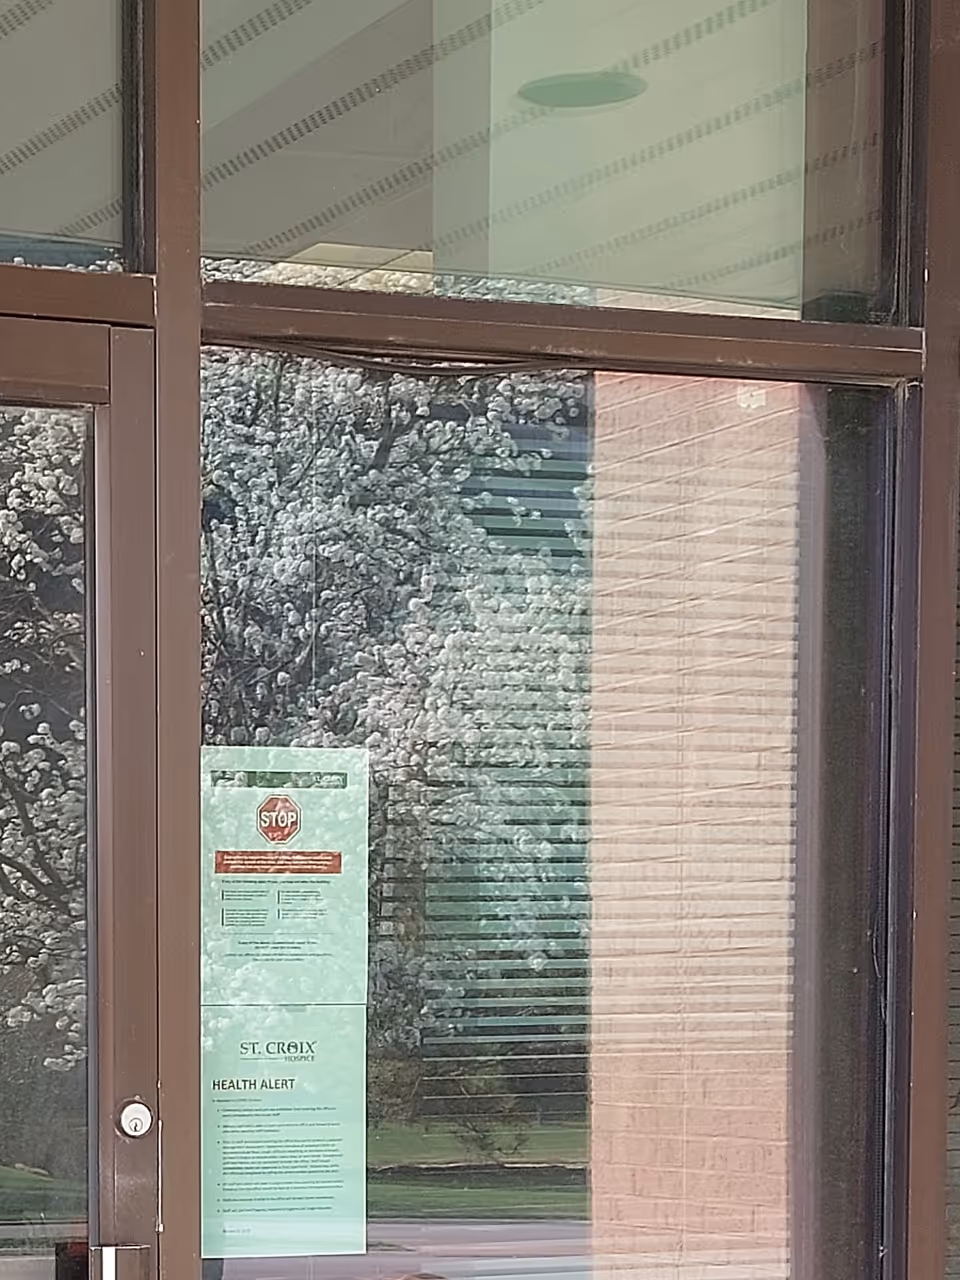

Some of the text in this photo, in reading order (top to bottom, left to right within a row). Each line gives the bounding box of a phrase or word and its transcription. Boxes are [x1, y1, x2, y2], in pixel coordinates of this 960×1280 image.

[260, 810, 297, 828] STOP
[239, 1040, 316, 1055] ST. CROIX
[212, 1078, 296, 1091] HEALTH ALERT
